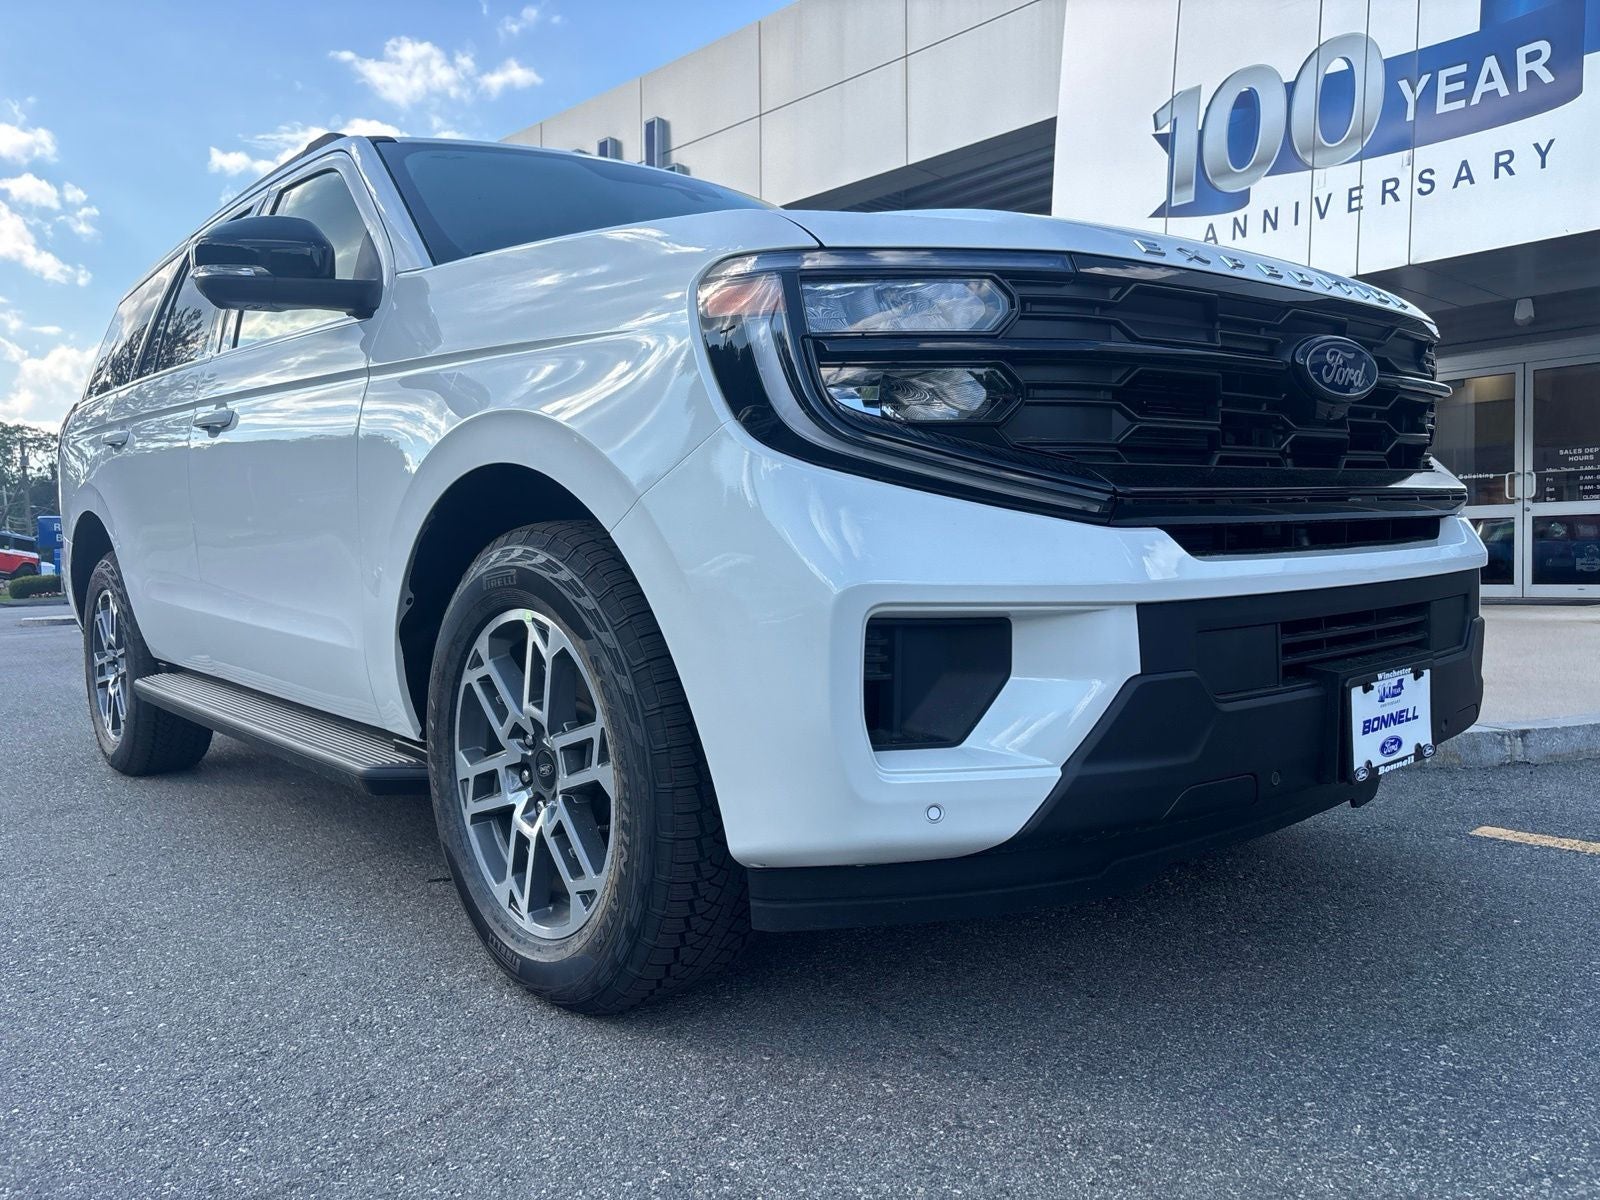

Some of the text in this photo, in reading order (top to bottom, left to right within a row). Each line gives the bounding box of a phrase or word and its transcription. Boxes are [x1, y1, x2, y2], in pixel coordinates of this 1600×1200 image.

[1153, 32, 1556, 208] 100 YEAR
[1203, 138, 1557, 246] ANNIVERSARY
[1321, 347, 1366, 390] Ford
[1559, 448, 1583, 456] SALES
[1568, 454, 1595, 462] HOURS
[482, 568, 517, 592] PIRELLI
[1378, 668, 1411, 680] Winchester
[1362, 706, 1418, 735] BONNELL
[1378, 755, 1415, 775] Bonnell
